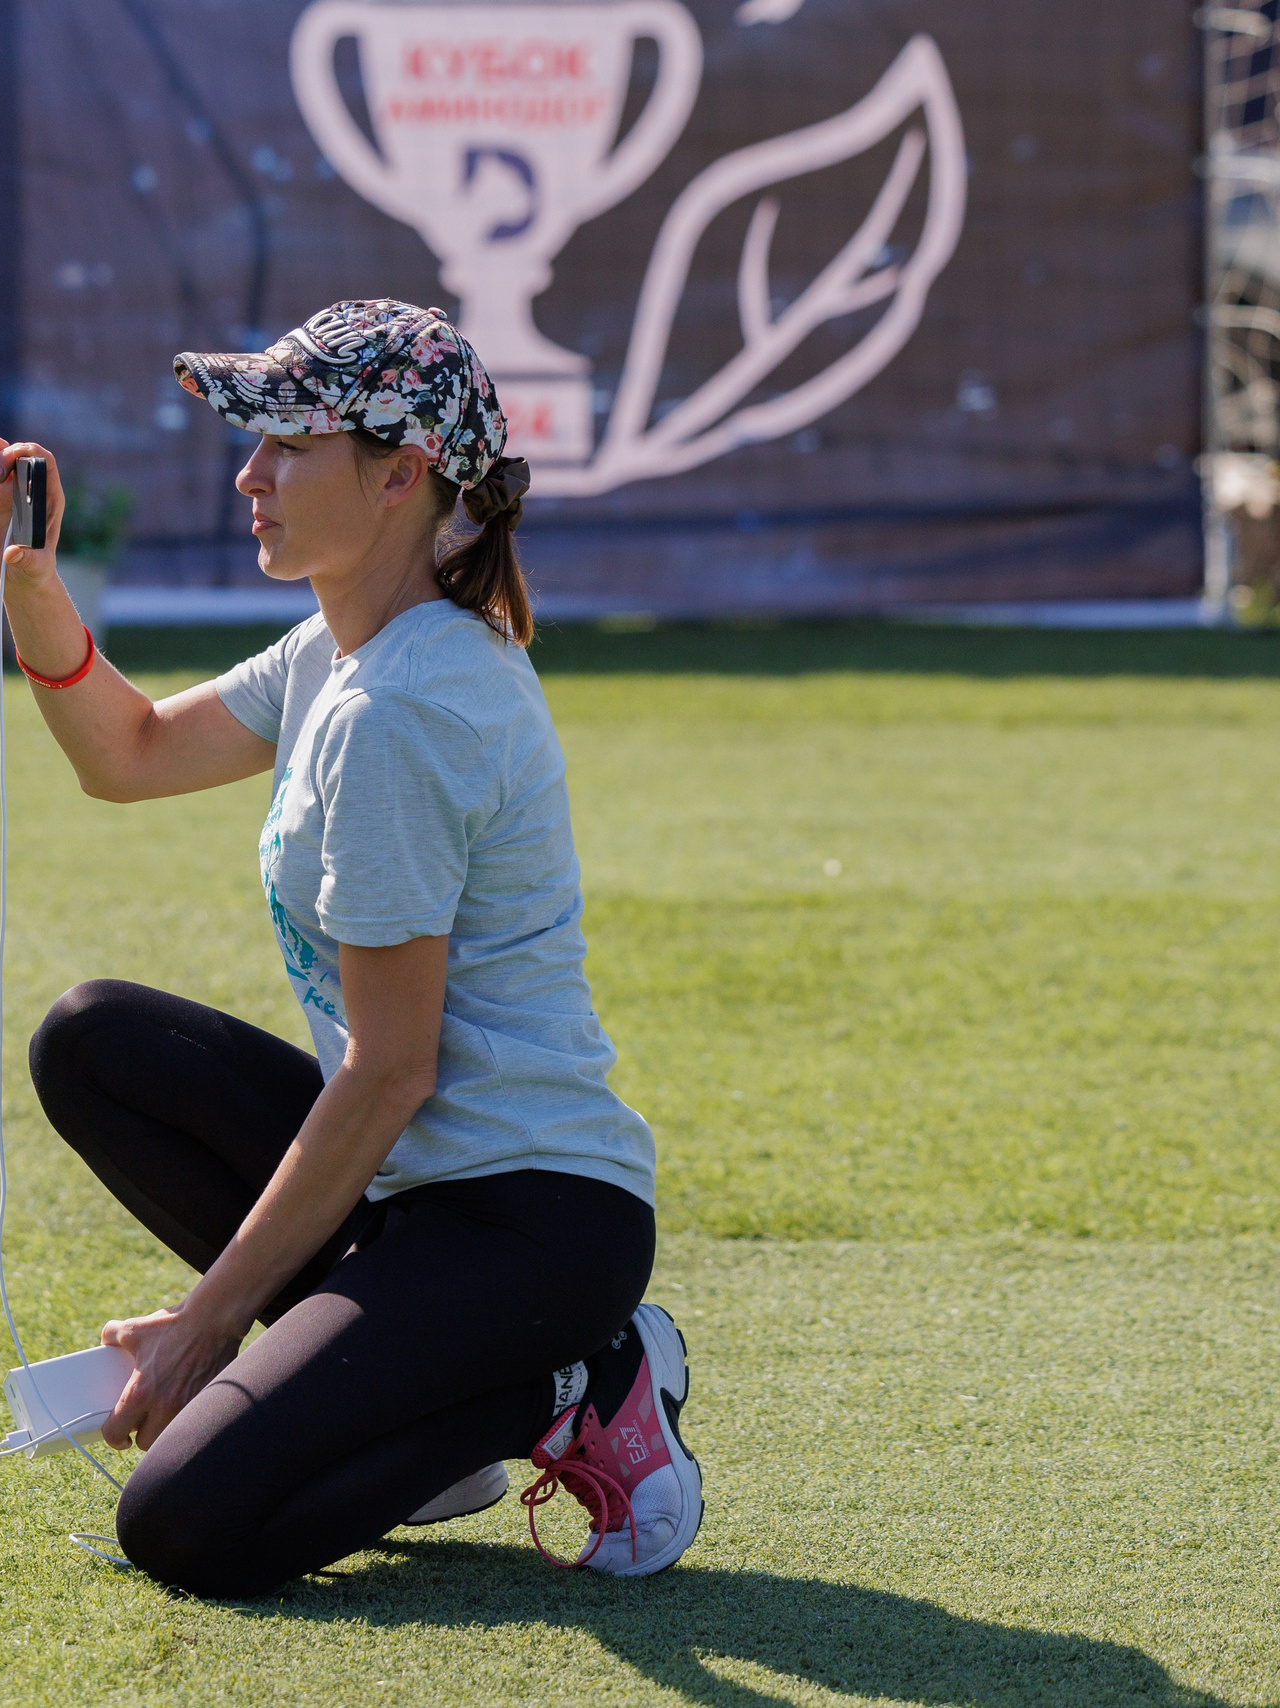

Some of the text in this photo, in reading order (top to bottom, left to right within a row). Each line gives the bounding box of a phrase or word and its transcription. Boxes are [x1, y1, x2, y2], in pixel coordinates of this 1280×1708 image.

[405, 42, 592, 82] КУБОК
[550, 1427, 575, 1455] EA
[619, 1426, 646, 1465] EA7
